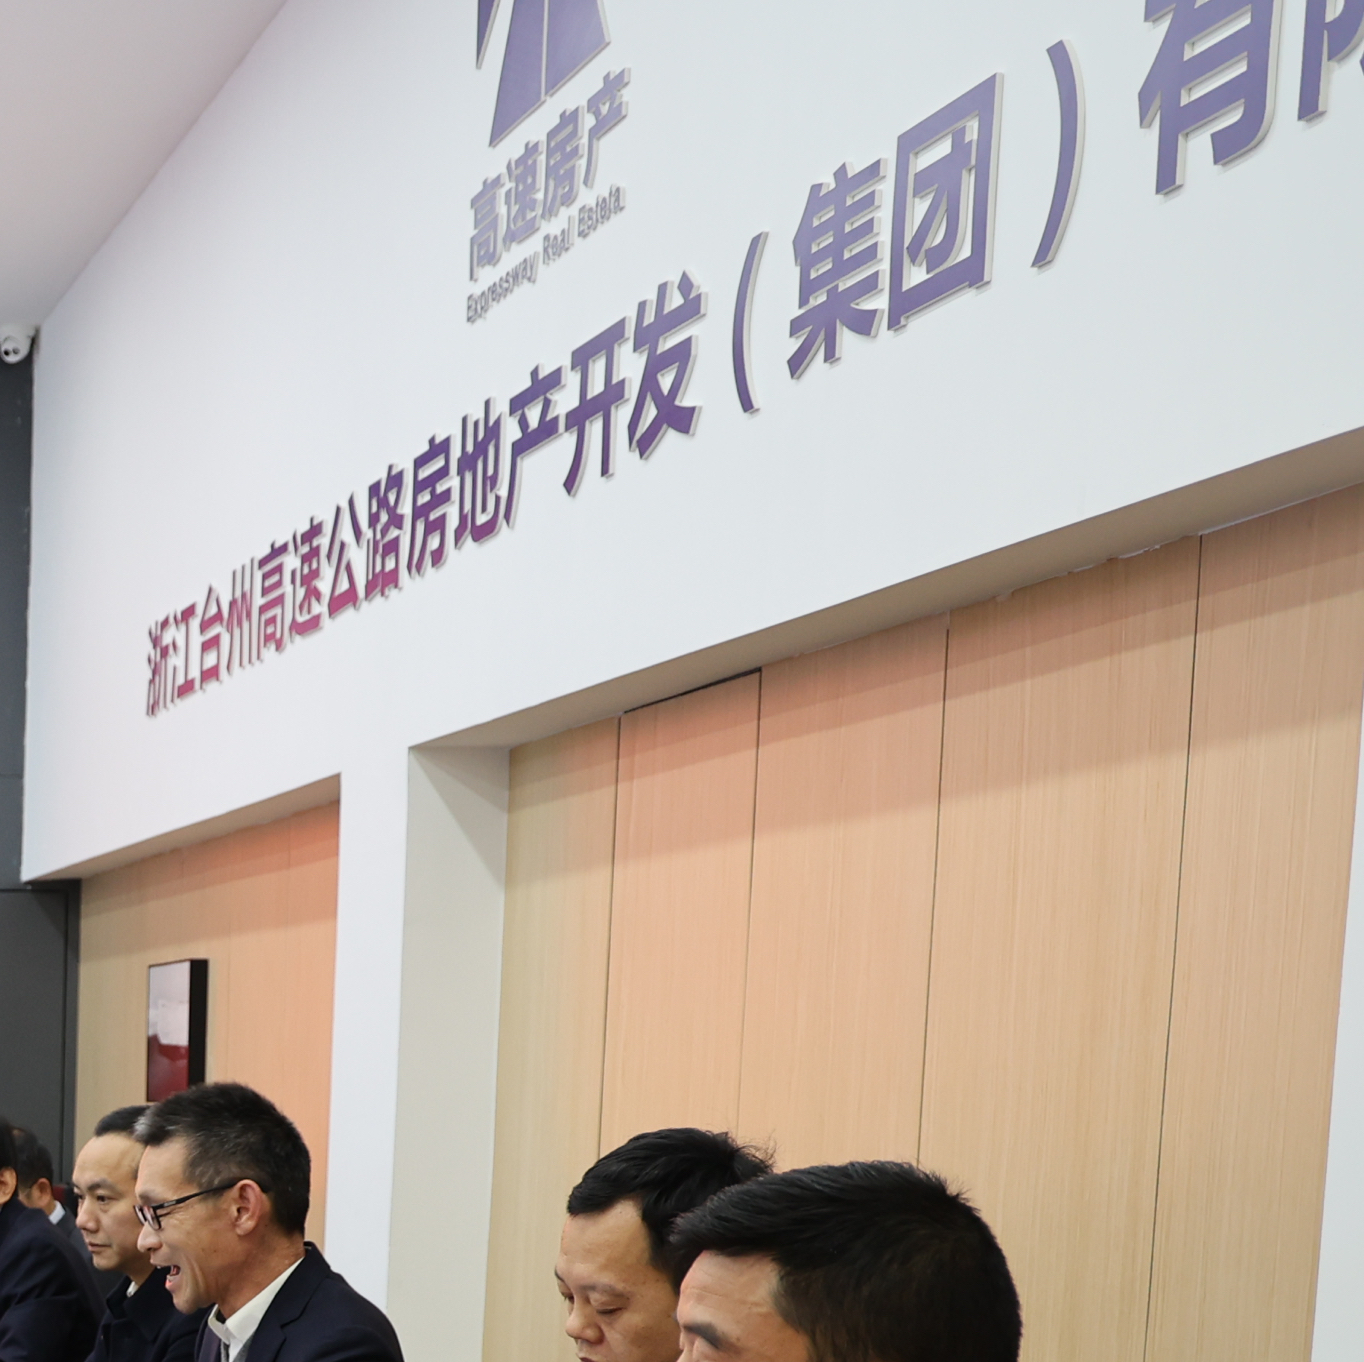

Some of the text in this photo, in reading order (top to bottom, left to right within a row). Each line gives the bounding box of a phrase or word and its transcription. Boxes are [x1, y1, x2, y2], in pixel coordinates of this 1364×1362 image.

[470, 66, 631, 283] 高速房产
[466, 250, 540, 325] Expressway
[542, 213, 575, 267] Real
